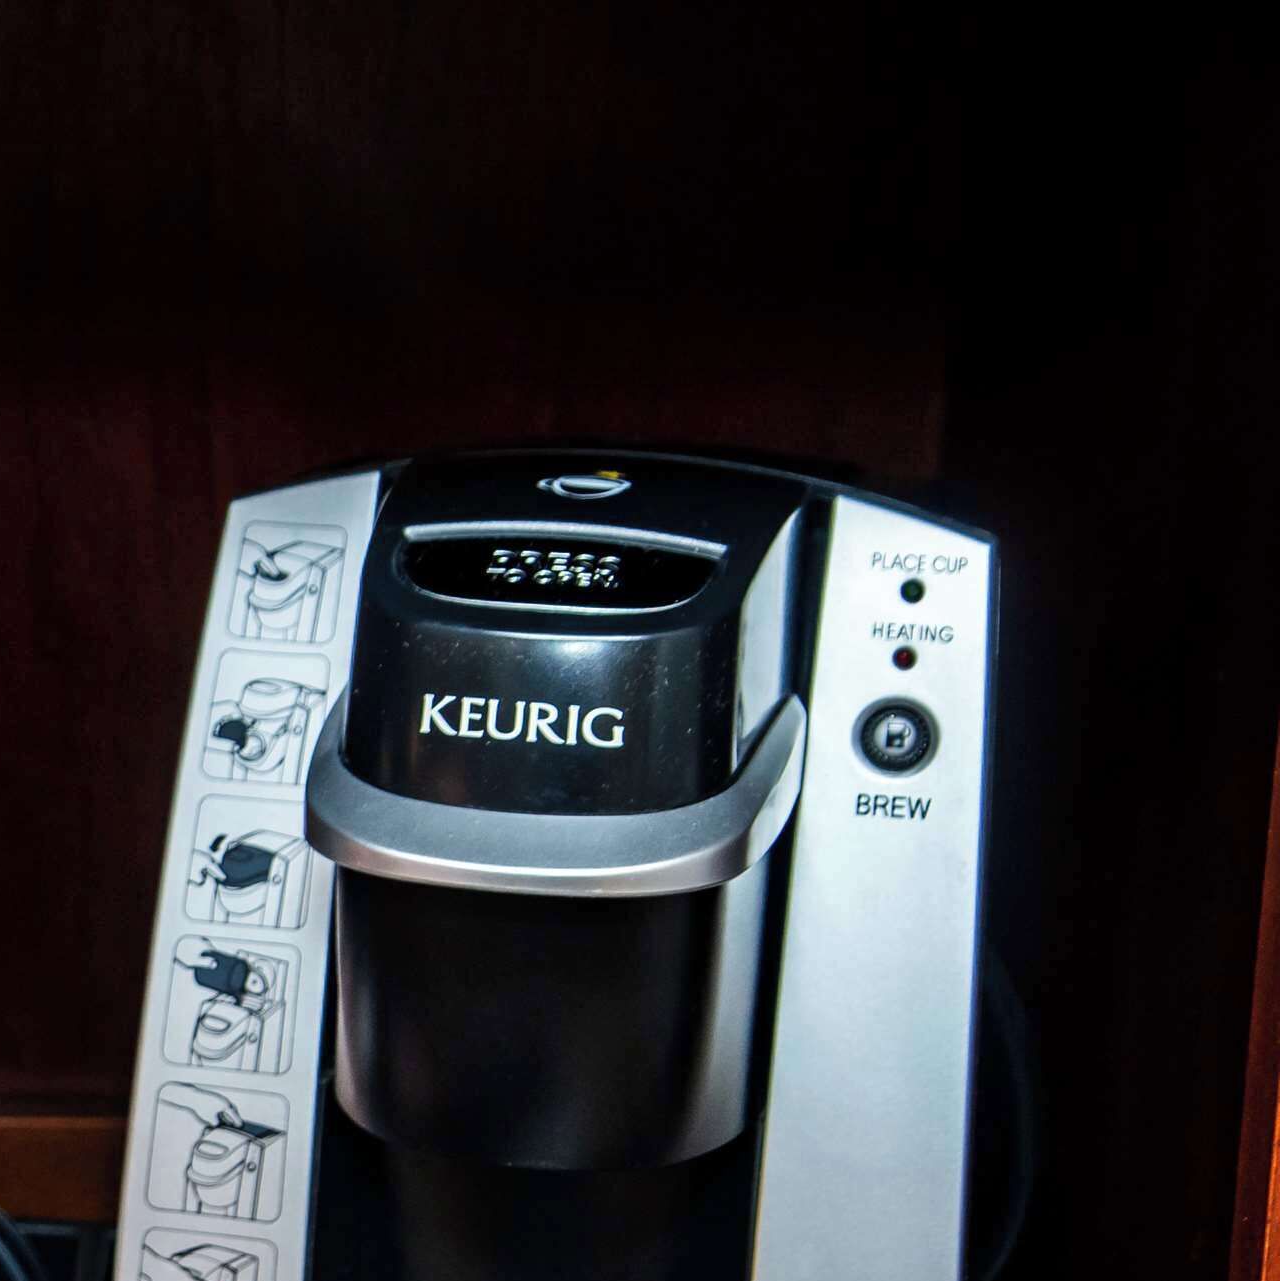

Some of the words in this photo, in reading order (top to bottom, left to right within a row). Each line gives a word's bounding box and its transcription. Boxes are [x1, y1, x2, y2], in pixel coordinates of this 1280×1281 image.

[870, 552, 926, 573] PLACE
[932, 554, 969, 575] CUP
[871, 621, 955, 644] HEATING
[419, 693, 625, 749] KEURIG
[855, 793, 933, 821] BREW
